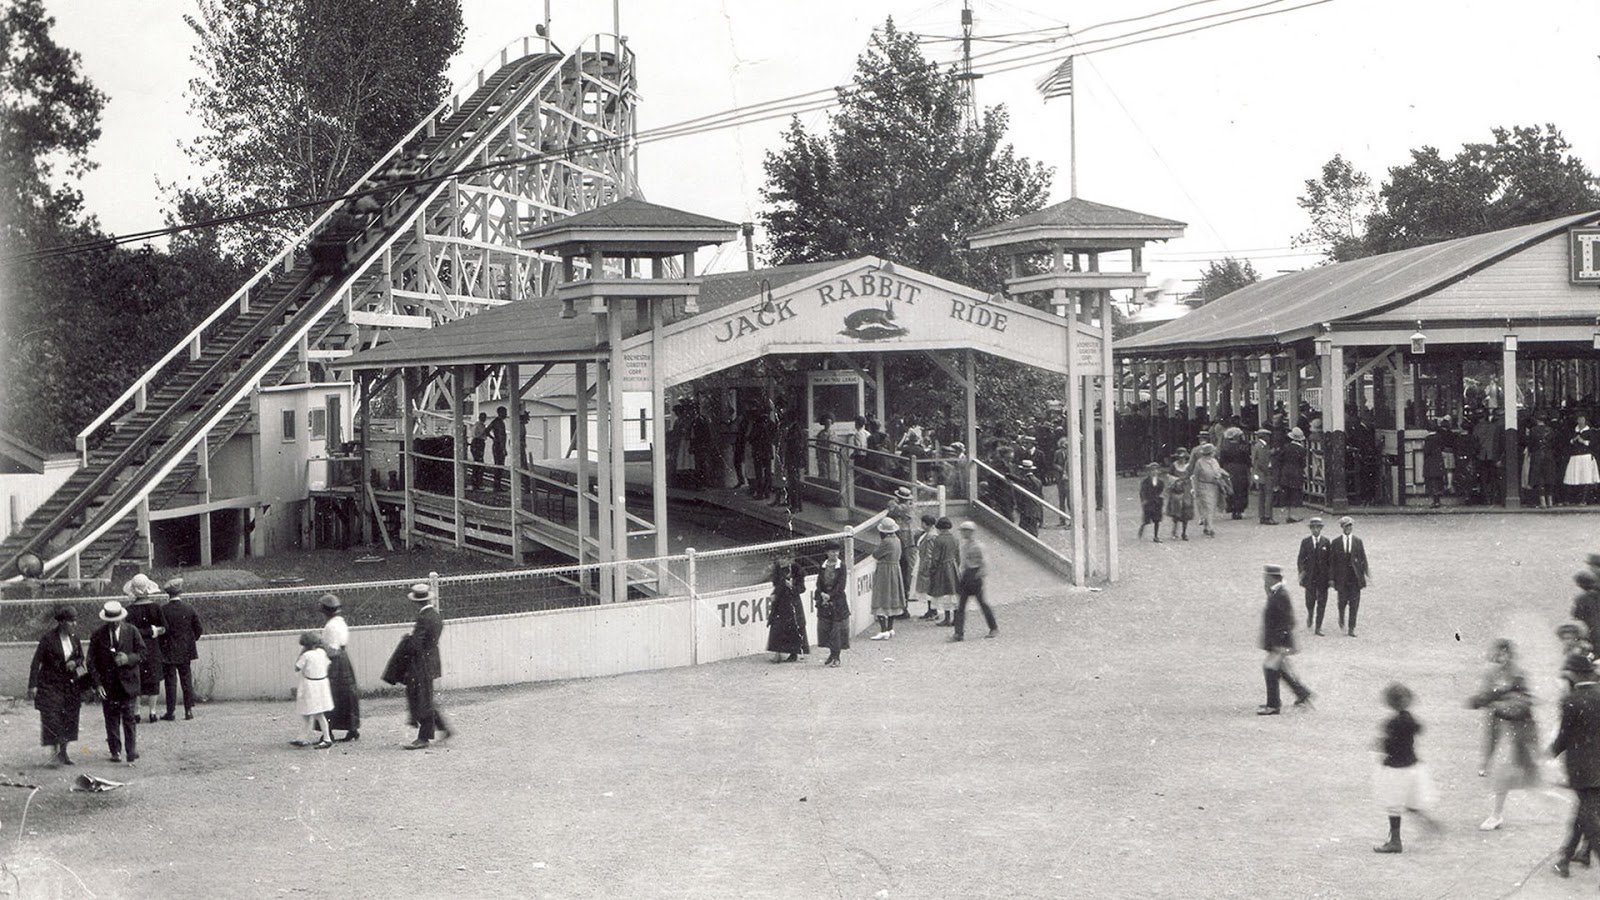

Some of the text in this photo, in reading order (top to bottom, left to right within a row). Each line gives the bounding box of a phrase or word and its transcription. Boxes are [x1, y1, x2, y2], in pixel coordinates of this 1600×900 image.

[714, 273, 1008, 343] JACK RABBIT RIDE
